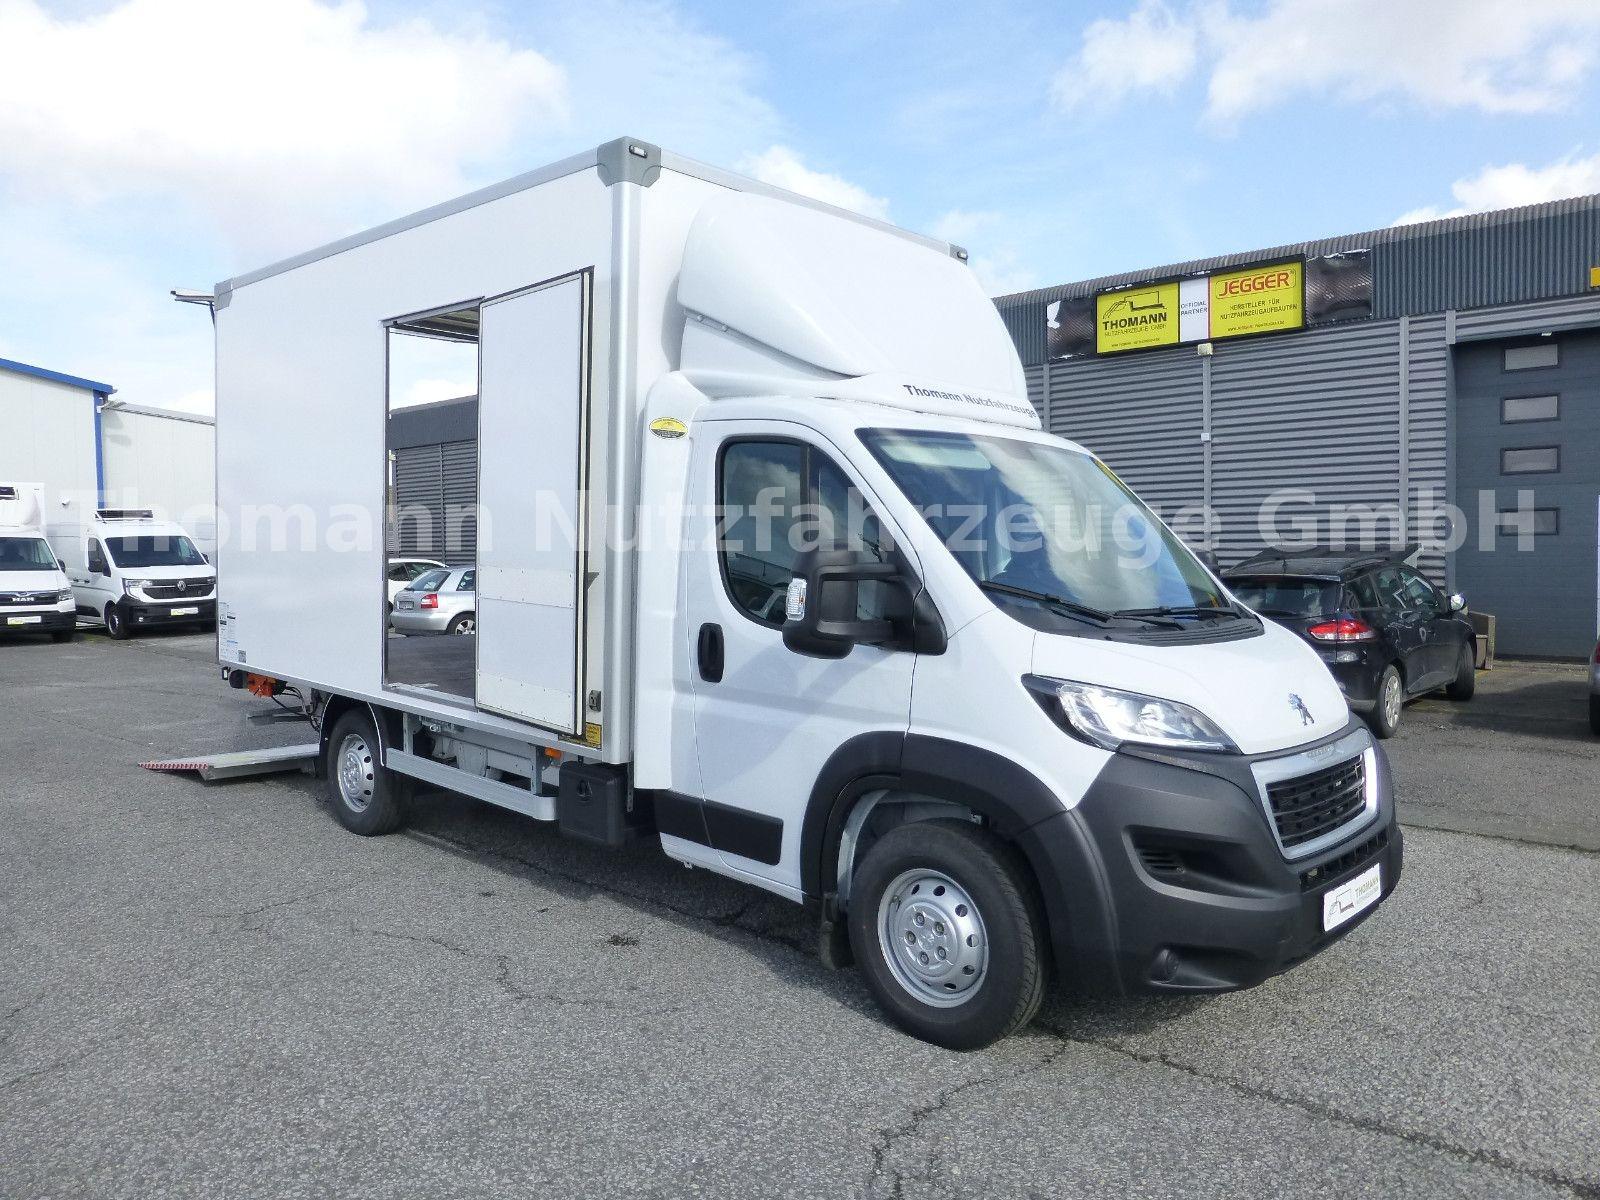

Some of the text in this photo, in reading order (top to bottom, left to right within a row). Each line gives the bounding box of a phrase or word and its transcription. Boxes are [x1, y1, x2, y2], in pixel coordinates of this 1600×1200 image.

[1218, 272, 1290, 296] JEGGER
[1102, 312, 1167, 330] THOMANN
[903, 384, 1037, 418] Thomann Nutzfahrzeuge
